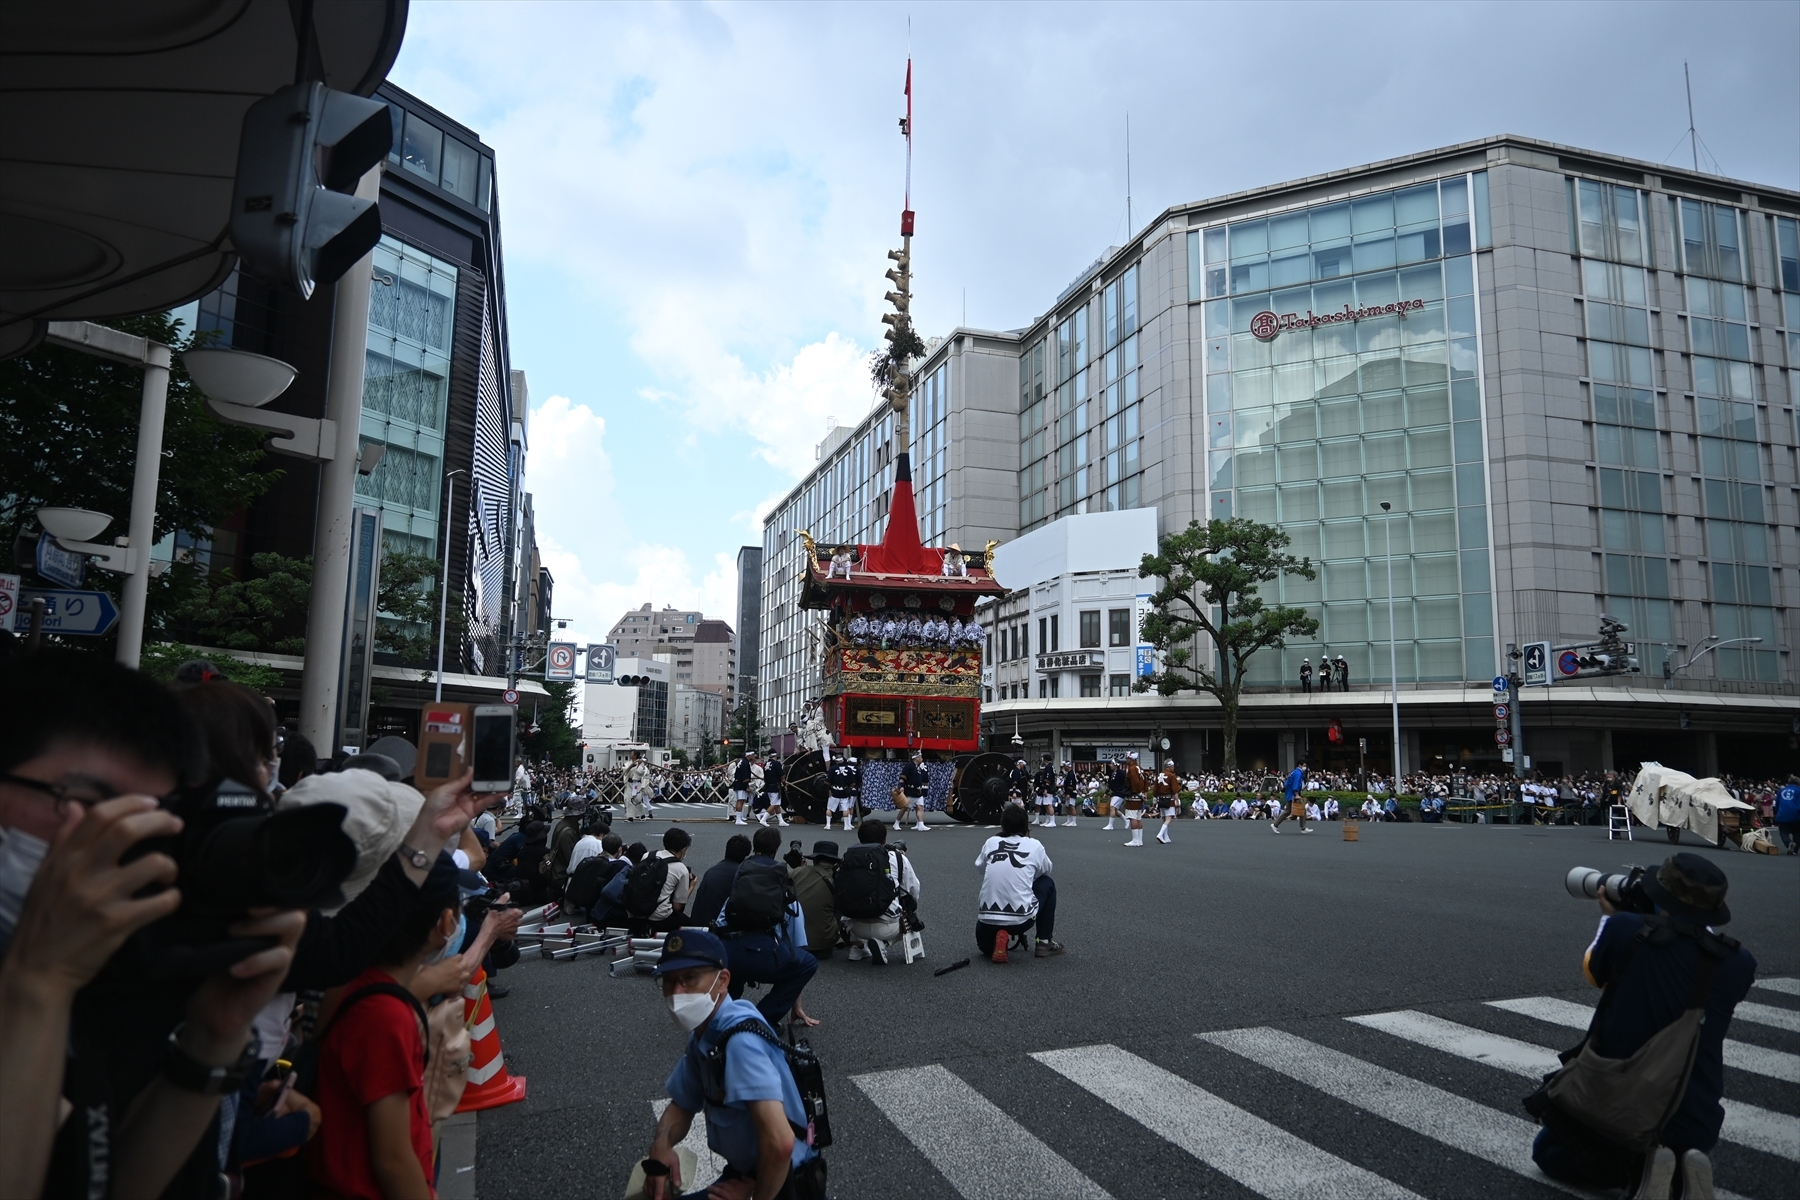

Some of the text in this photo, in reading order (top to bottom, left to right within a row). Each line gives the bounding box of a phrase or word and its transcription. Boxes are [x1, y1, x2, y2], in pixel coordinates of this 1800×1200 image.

[1281, 298, 1424, 331] Takashimaya
[42, 616, 62, 627] ori
[1102, 752, 1127, 760] コンタク
